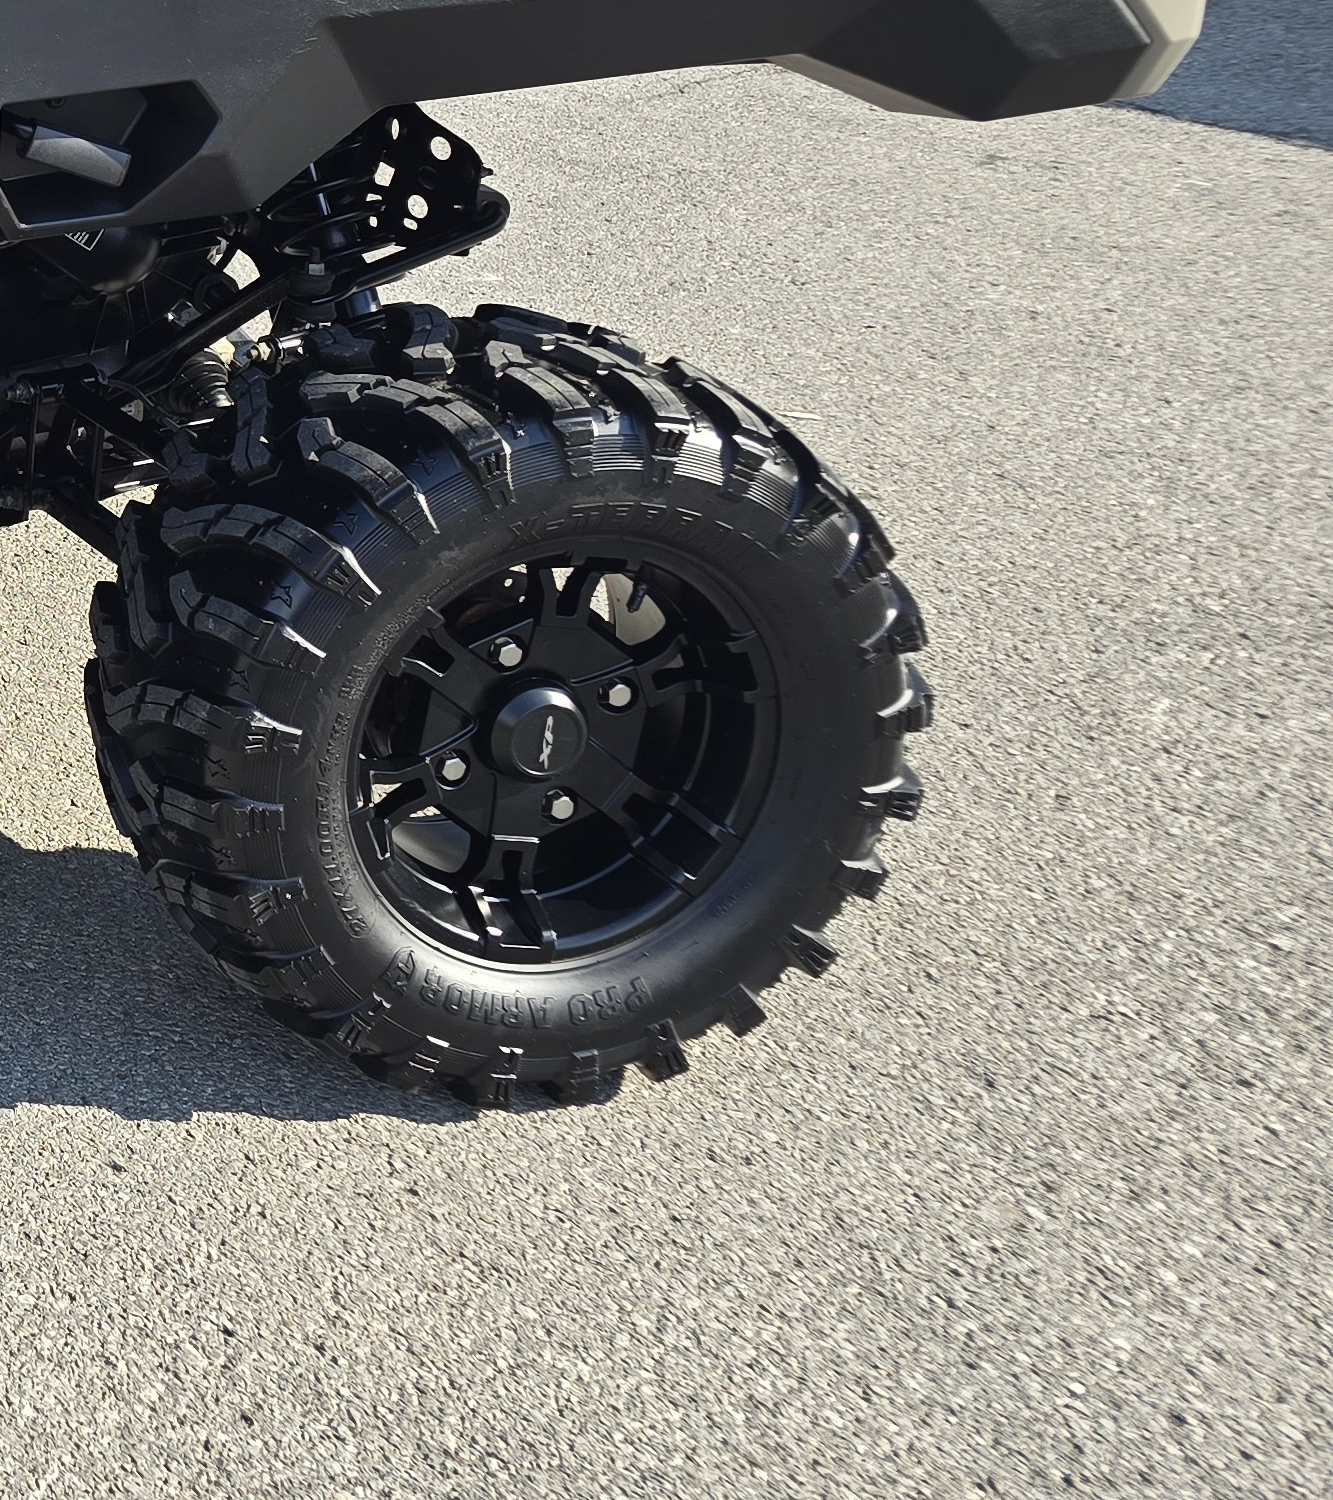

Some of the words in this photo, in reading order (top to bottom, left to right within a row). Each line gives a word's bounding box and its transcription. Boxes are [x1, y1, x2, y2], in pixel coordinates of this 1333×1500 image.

[538, 715, 554, 770] XP
[419, 966, 557, 1029] ARMOR
[567, 976, 655, 1027] PRO
